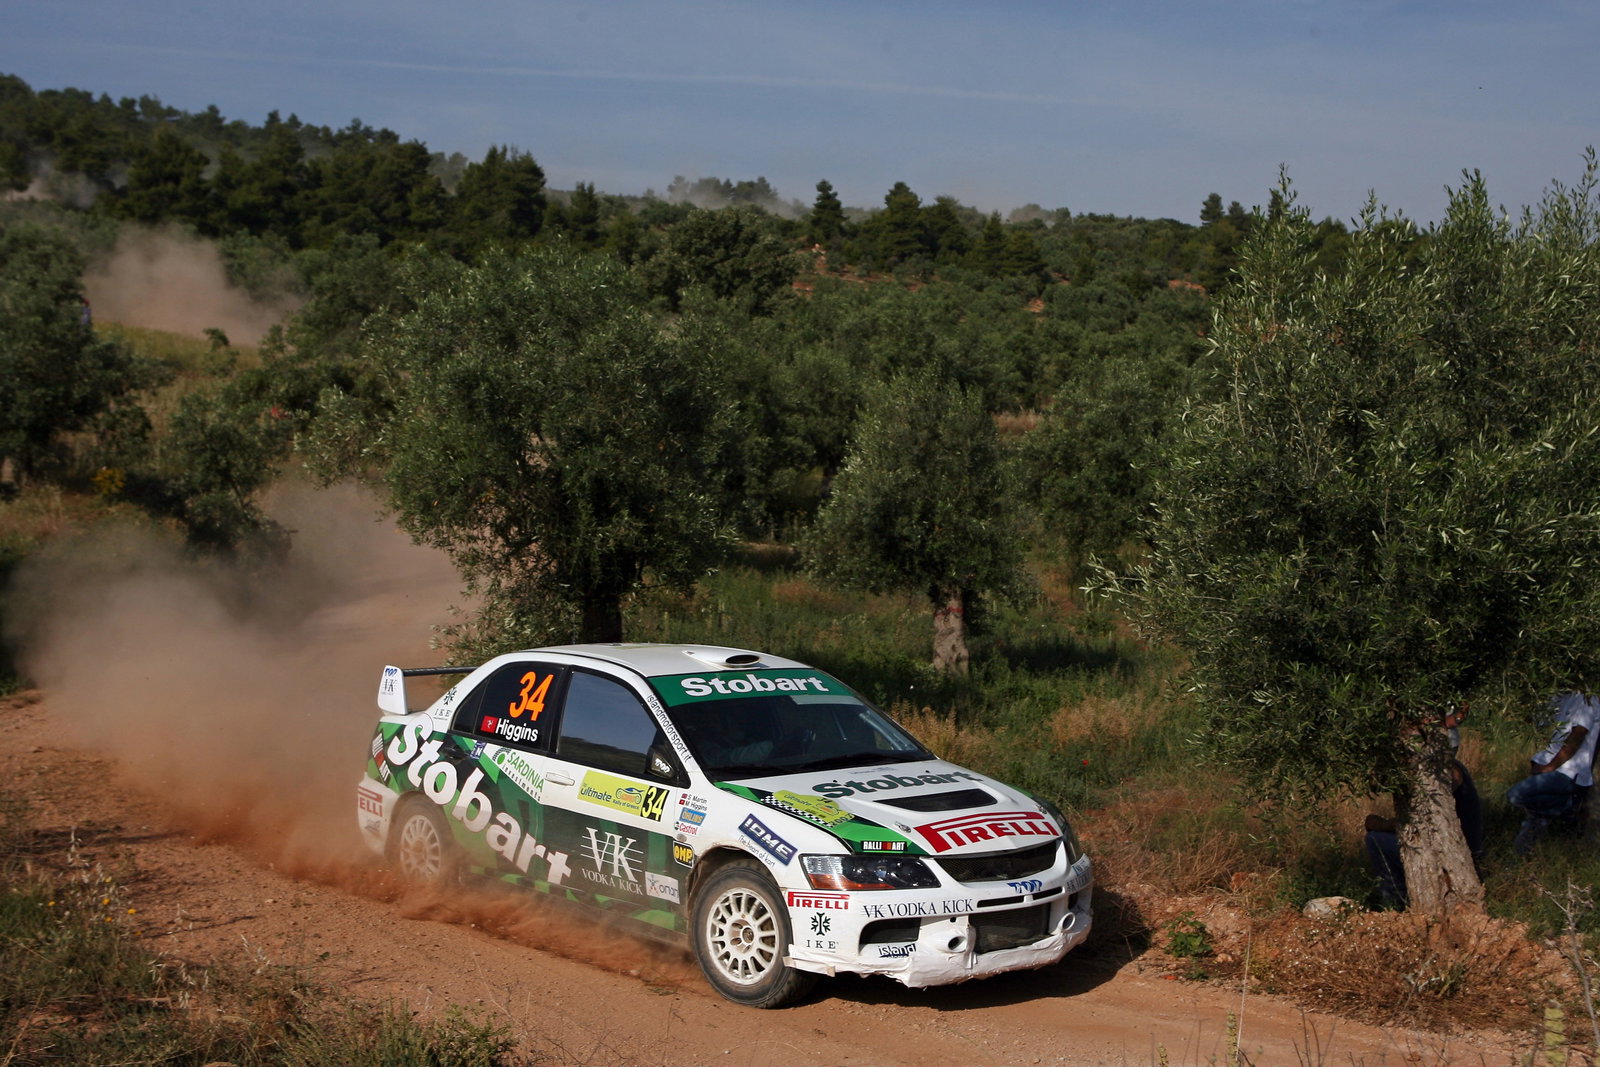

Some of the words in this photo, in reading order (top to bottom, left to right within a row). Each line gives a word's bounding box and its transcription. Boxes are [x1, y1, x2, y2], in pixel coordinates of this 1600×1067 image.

[509, 671, 554, 722] 34
[680, 673, 829, 697] Stobart
[495, 718, 539, 742] Higgins
[502, 763, 541, 802] investments
[507, 751, 545, 792] SARDINIA
[580, 787, 612, 802] ultimate
[812, 771, 983, 799] Stobart
[387, 713, 571, 884] Stobart
[641, 786, 668, 821] 34
[679, 823, 698, 835] Castrol
[913, 811, 1059, 853] PIRELLI
[586, 827, 638, 883] VK
[674, 845, 693, 862] OMP
[863, 841, 882, 851] RALLI
[892, 841, 906, 851] ART
[582, 868, 616, 888] VODKA
[619, 878, 643, 896] KICK
[788, 891, 850, 910] PIRELLI
[863, 904, 885, 918] VK
[888, 901, 937, 917] VODKA
[943, 899, 974, 914] KICK
[806, 939, 837, 950] IKE
[878, 943, 917, 956] island
